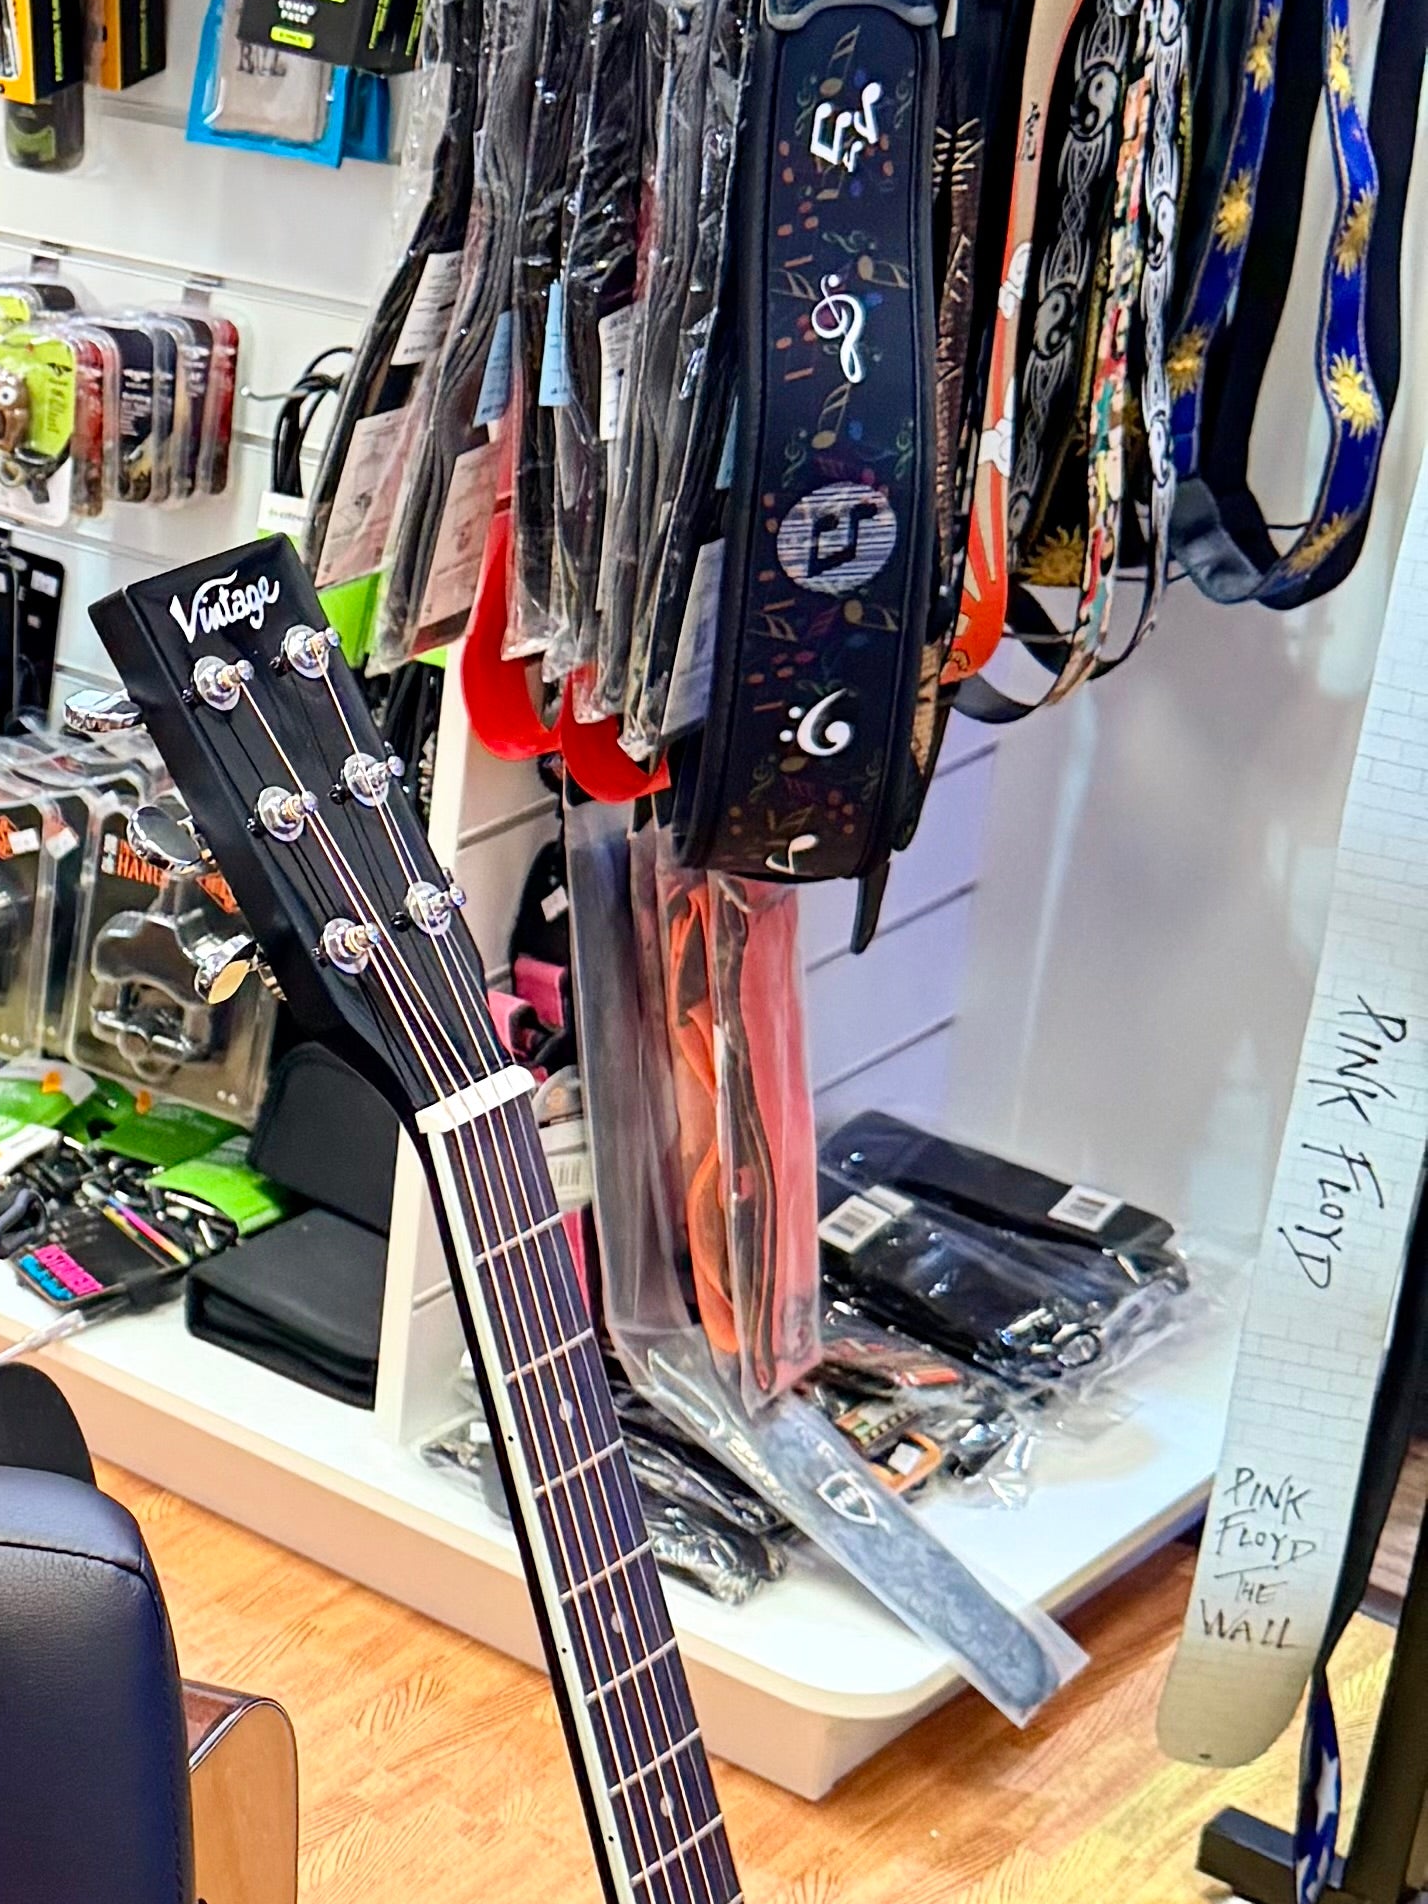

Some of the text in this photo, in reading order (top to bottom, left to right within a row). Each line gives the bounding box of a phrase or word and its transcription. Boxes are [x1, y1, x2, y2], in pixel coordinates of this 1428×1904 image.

[279, 9, 310, 25] PACK
[169, 568, 281, 645] Vintage
[1307, 993, 1409, 1127] PINK
[1277, 1142, 1385, 1293] FLOYD
[1223, 1465, 1313, 1523] PINK
[1215, 1507, 1318, 1569] FLOYD
[1212, 1564, 1293, 1610] THE
[1199, 1598, 1299, 1650] WALL
